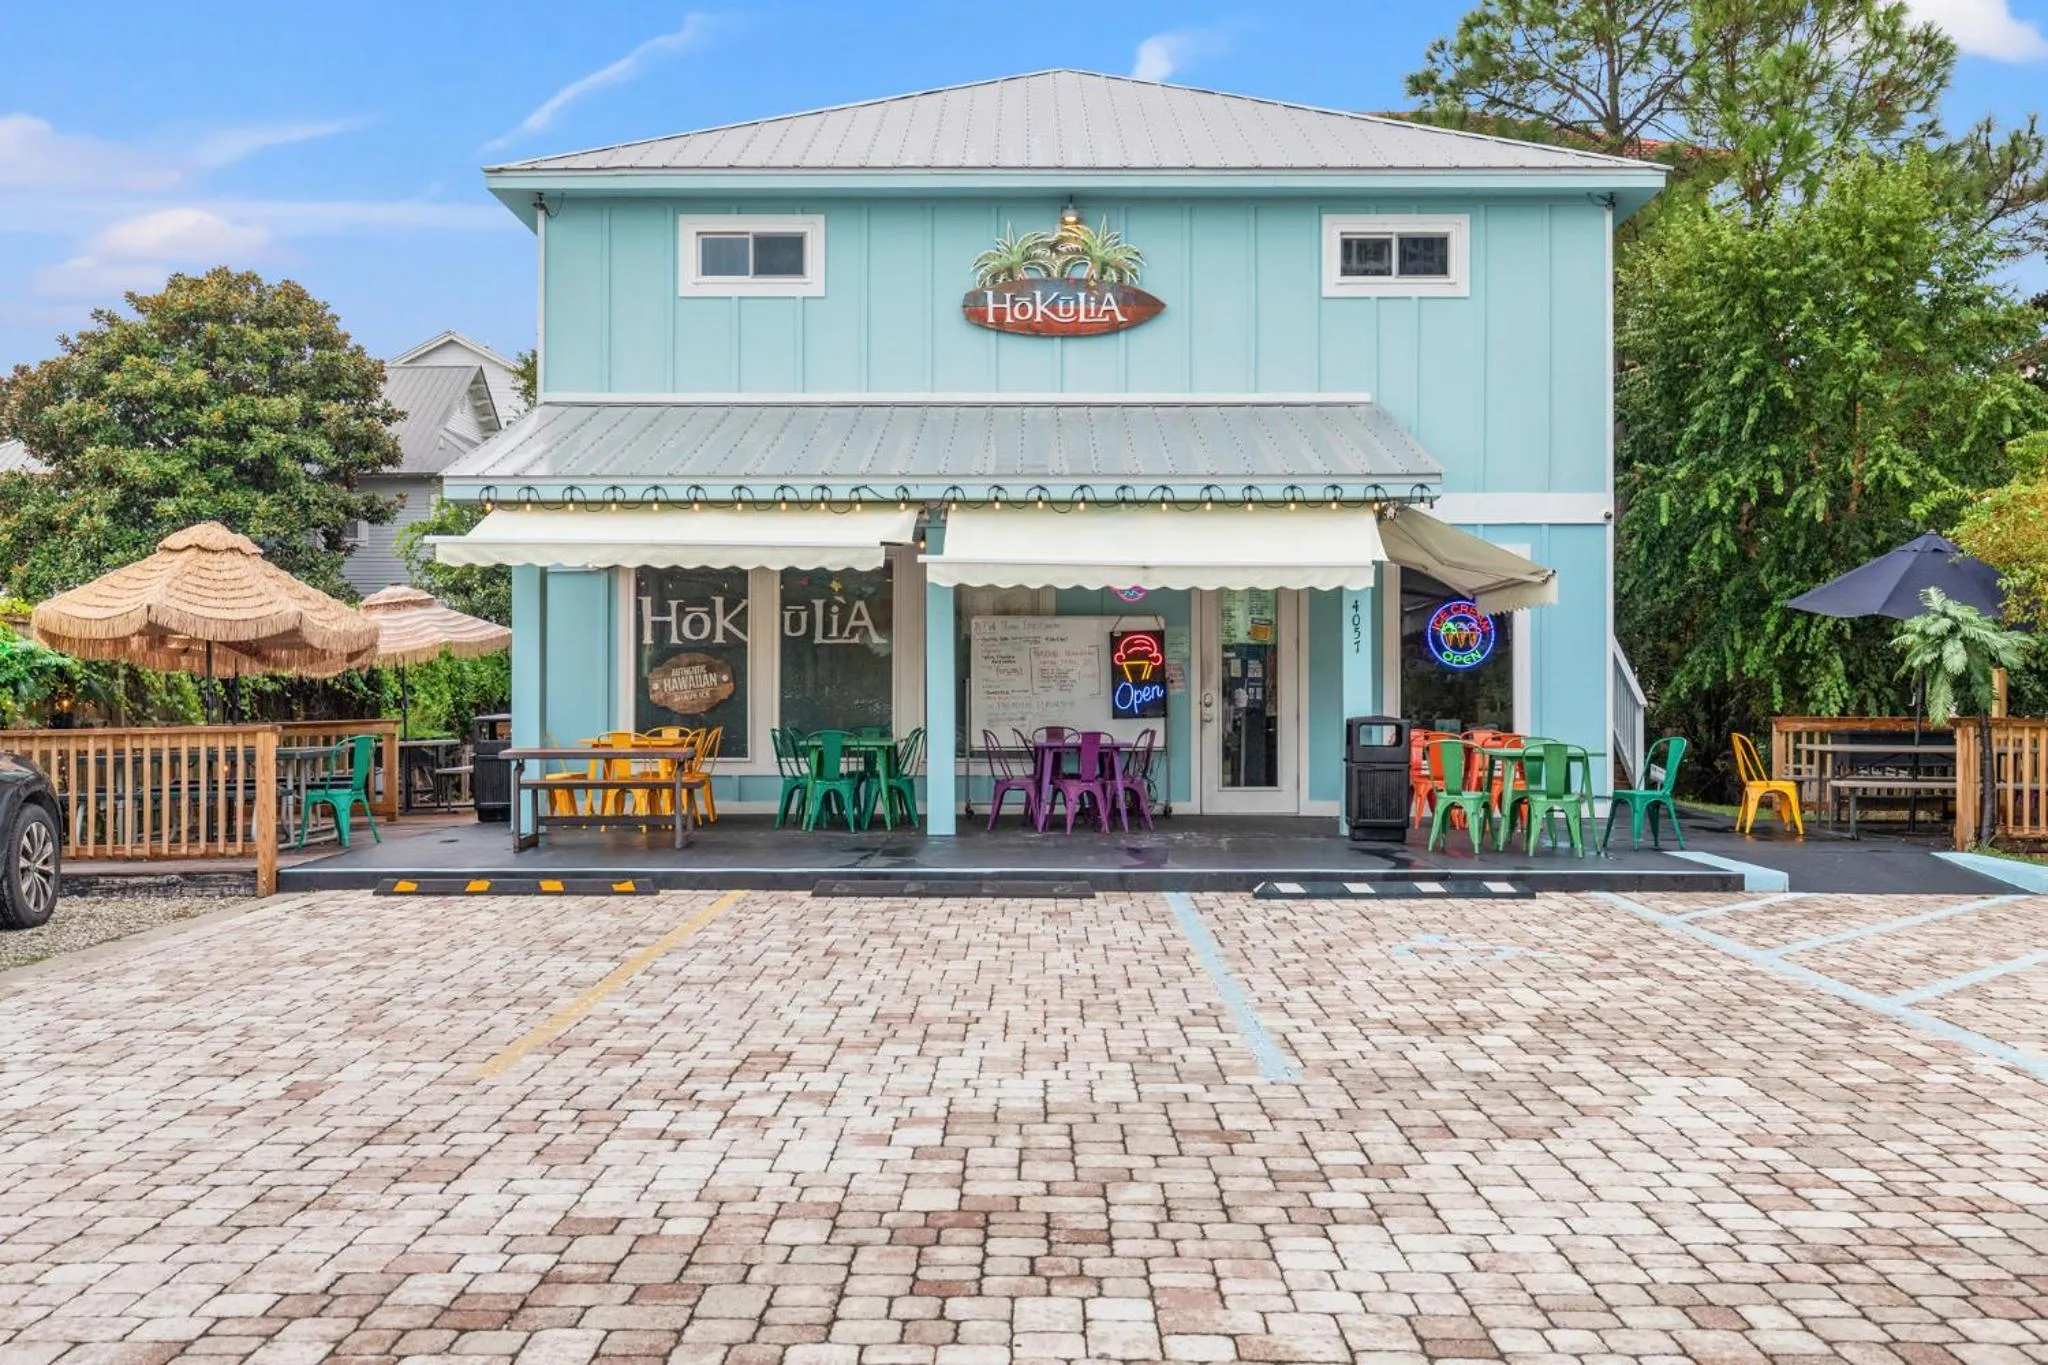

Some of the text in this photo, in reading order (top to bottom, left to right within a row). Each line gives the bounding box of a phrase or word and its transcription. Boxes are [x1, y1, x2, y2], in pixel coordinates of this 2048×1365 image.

[1432, 609, 1449, 632] ICE
[1442, 649, 1482, 665] OPEN
[663, 672, 719, 693] HAWAIIAN
[1115, 682, 1164, 714] Open
